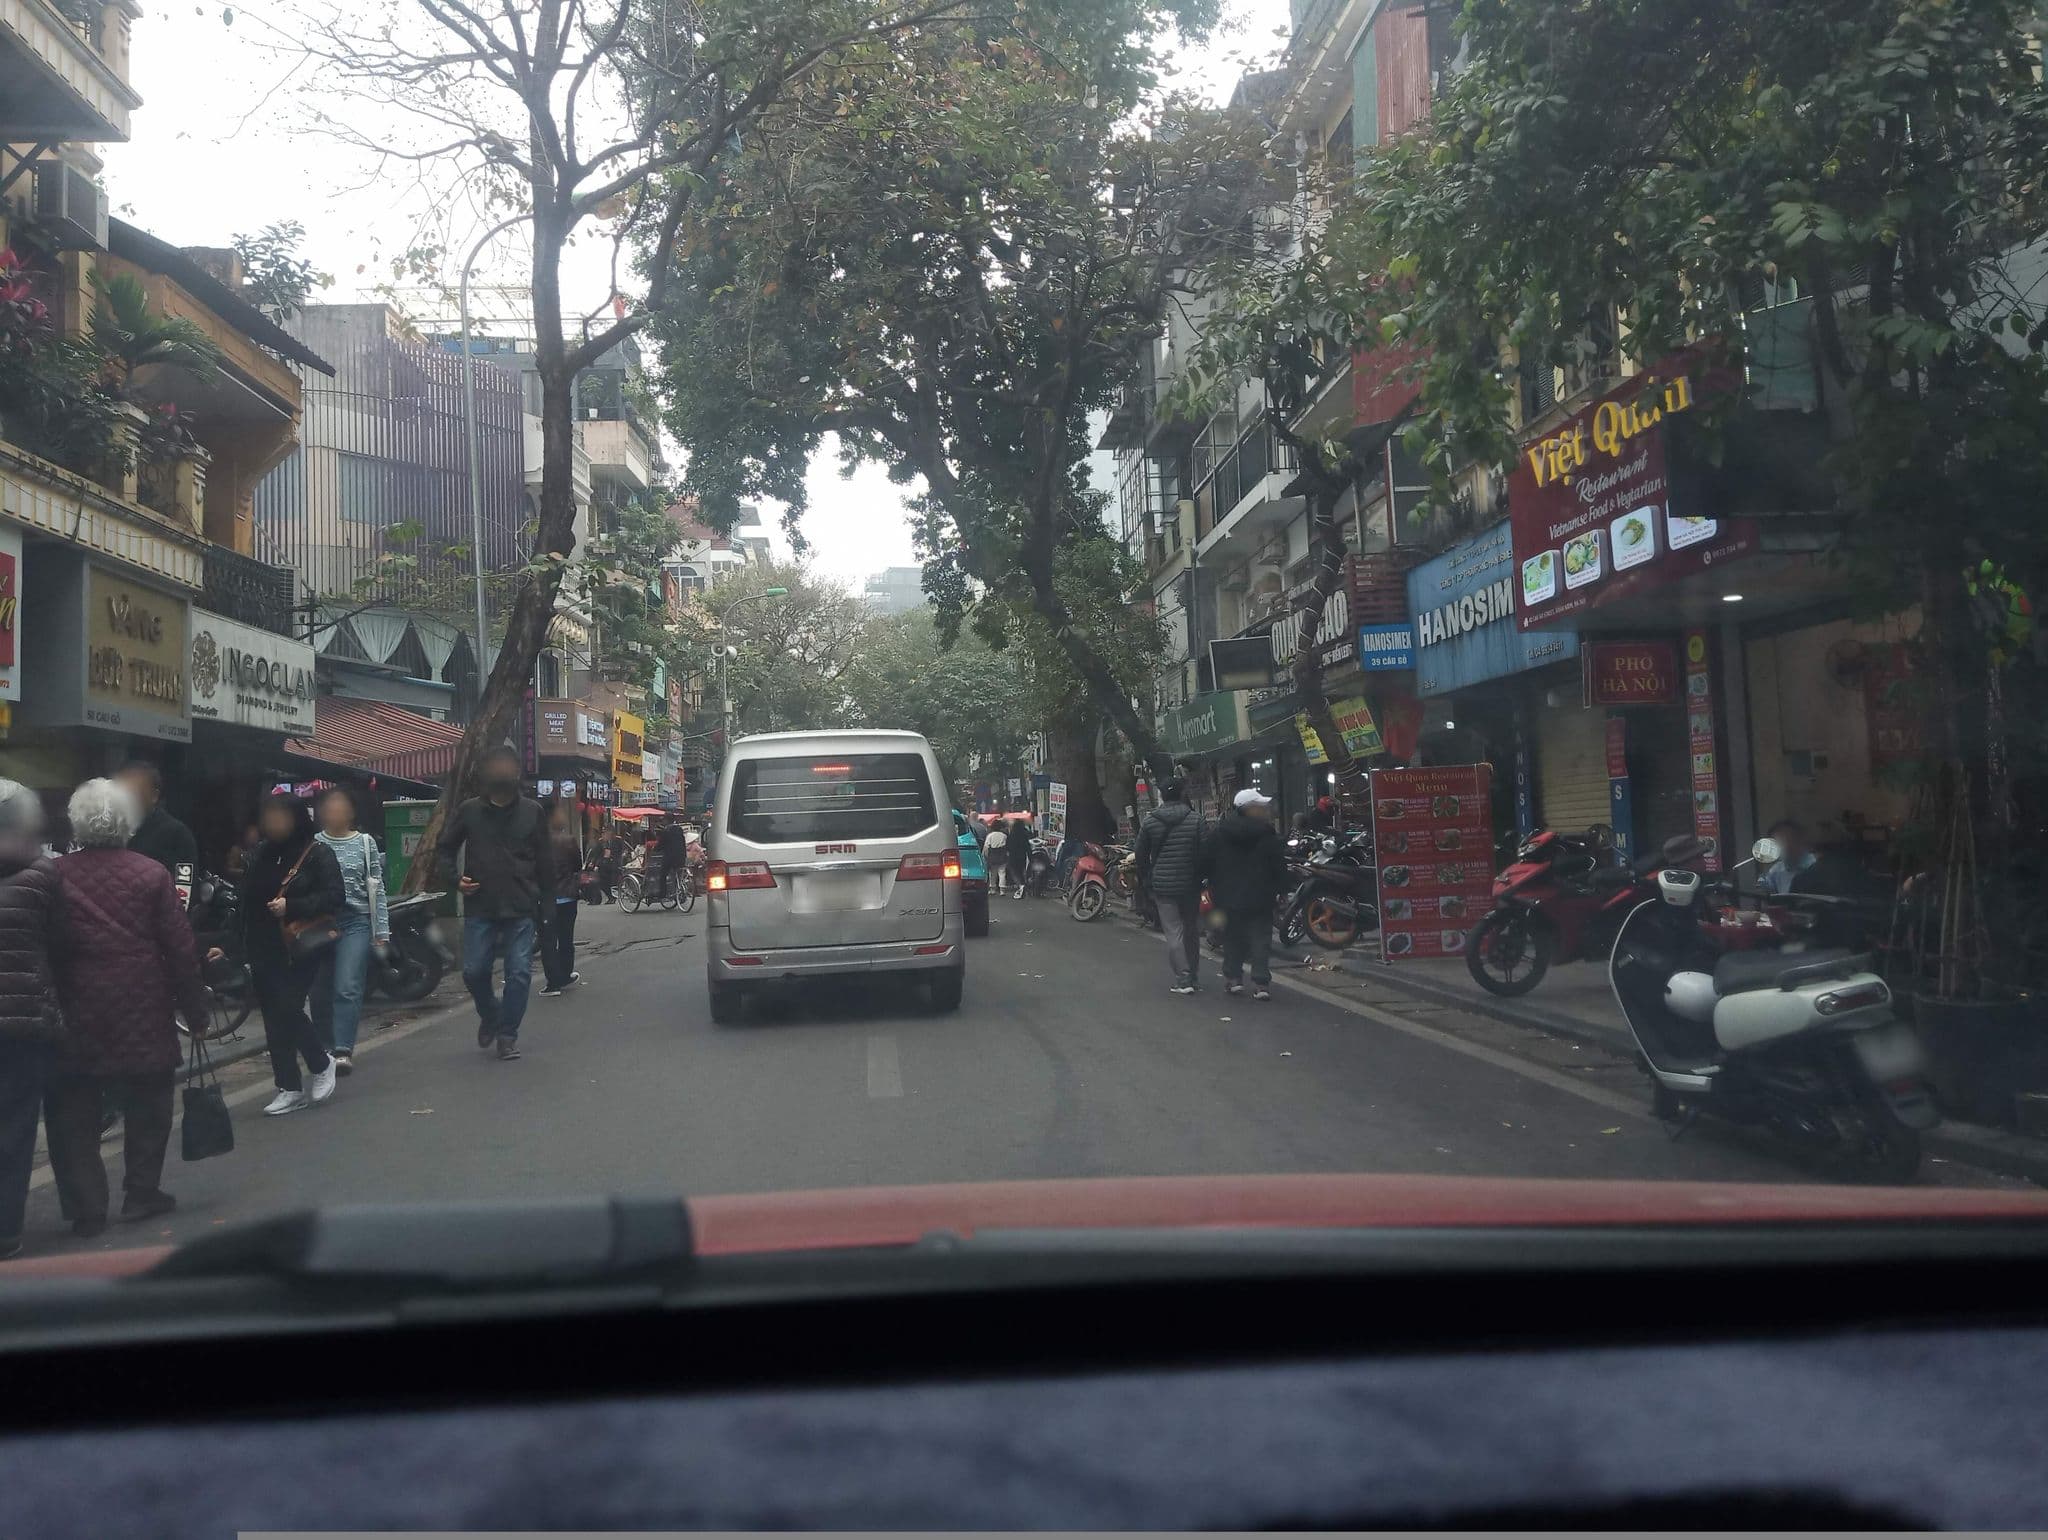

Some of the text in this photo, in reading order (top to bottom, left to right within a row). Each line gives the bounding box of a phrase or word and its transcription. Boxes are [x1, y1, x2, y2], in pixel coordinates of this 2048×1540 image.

[1527, 423, 1586, 488] Việt
[1575, 449, 1648, 503] Restaurant
[1588, 502, 1609, 525] Food
[1363, 631, 1412, 652] HANOSIMEX
[1371, 658, 1381, 666] 39
[550, 726, 564, 734] RICE
[815, 843, 857, 855] SRM
